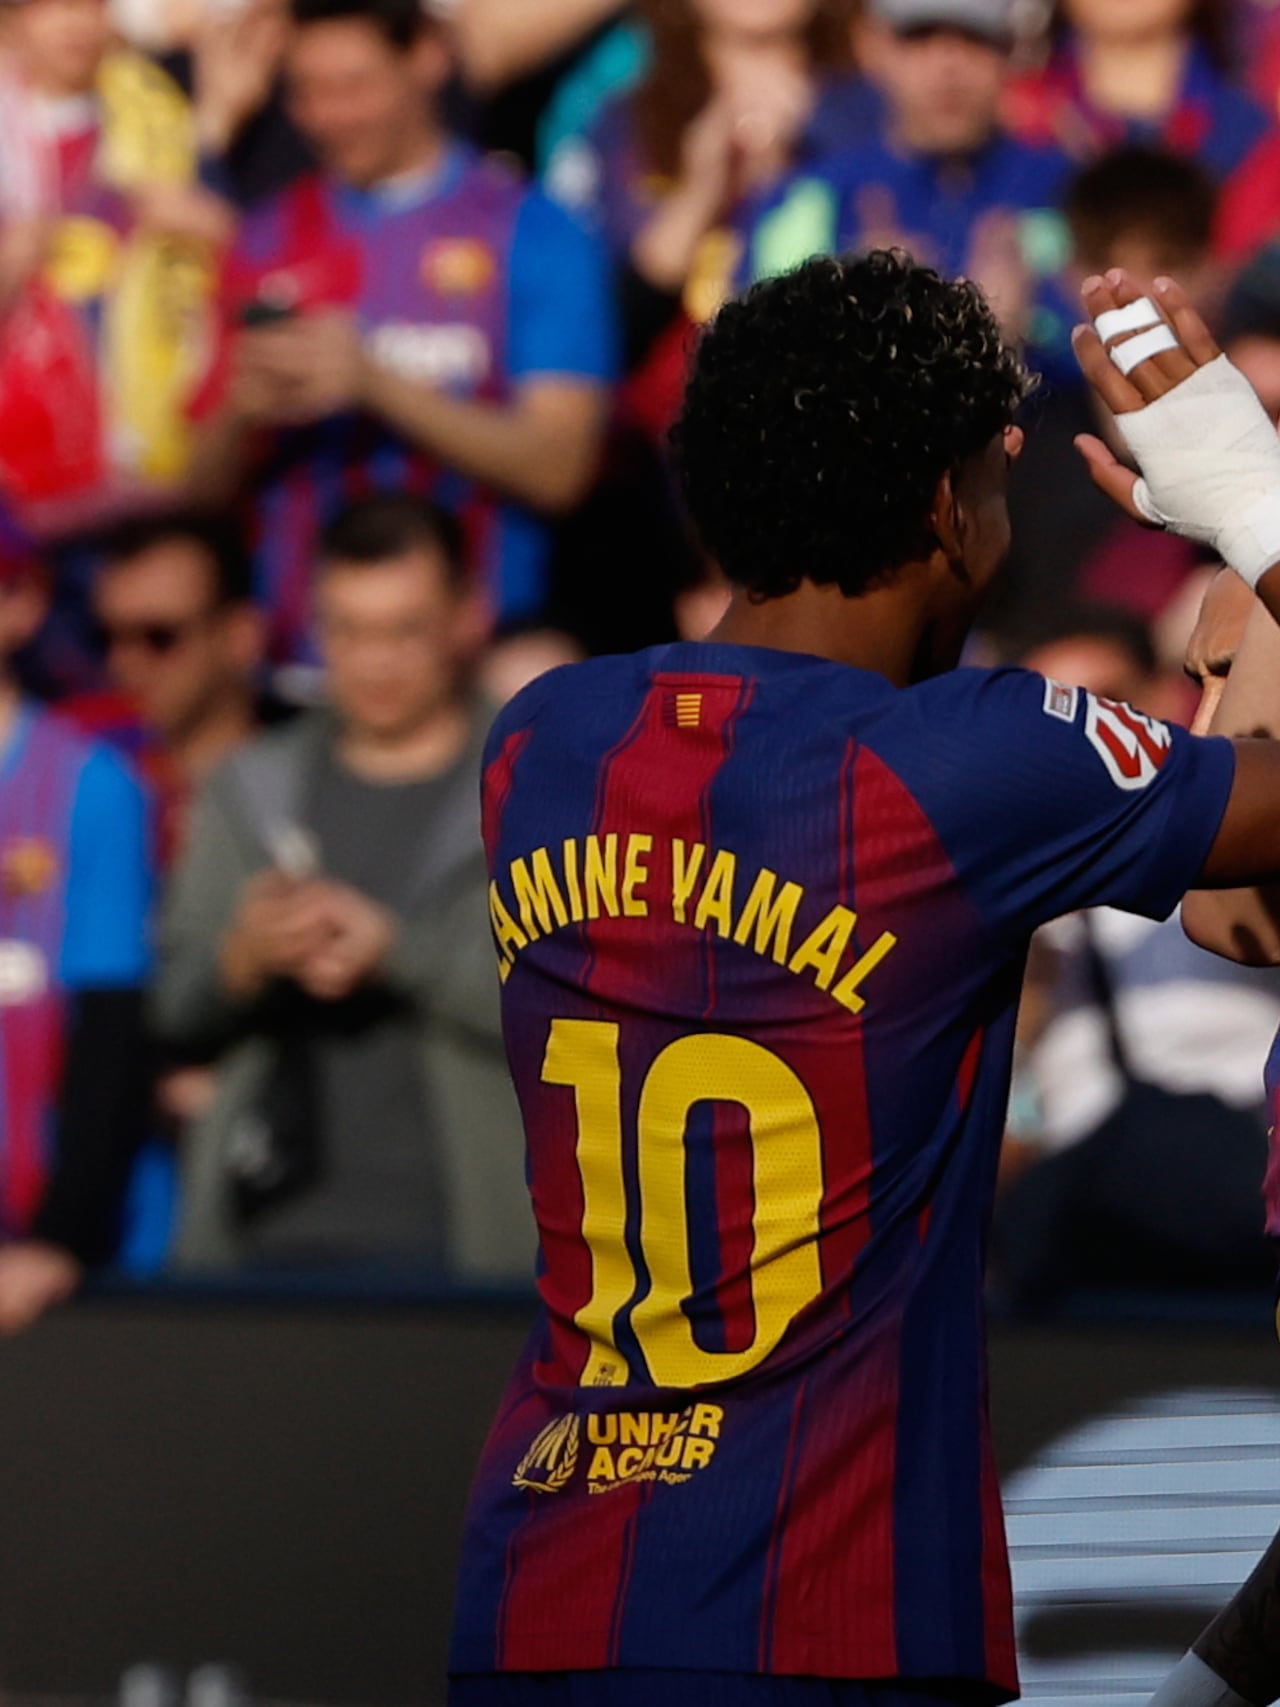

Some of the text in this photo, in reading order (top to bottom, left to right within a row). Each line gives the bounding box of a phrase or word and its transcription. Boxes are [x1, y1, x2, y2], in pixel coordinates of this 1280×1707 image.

[489, 833, 897, 1015] AMINE YAMAL
[541, 1018, 824, 1388] 10
[587, 1403, 723, 1446] UNHR
